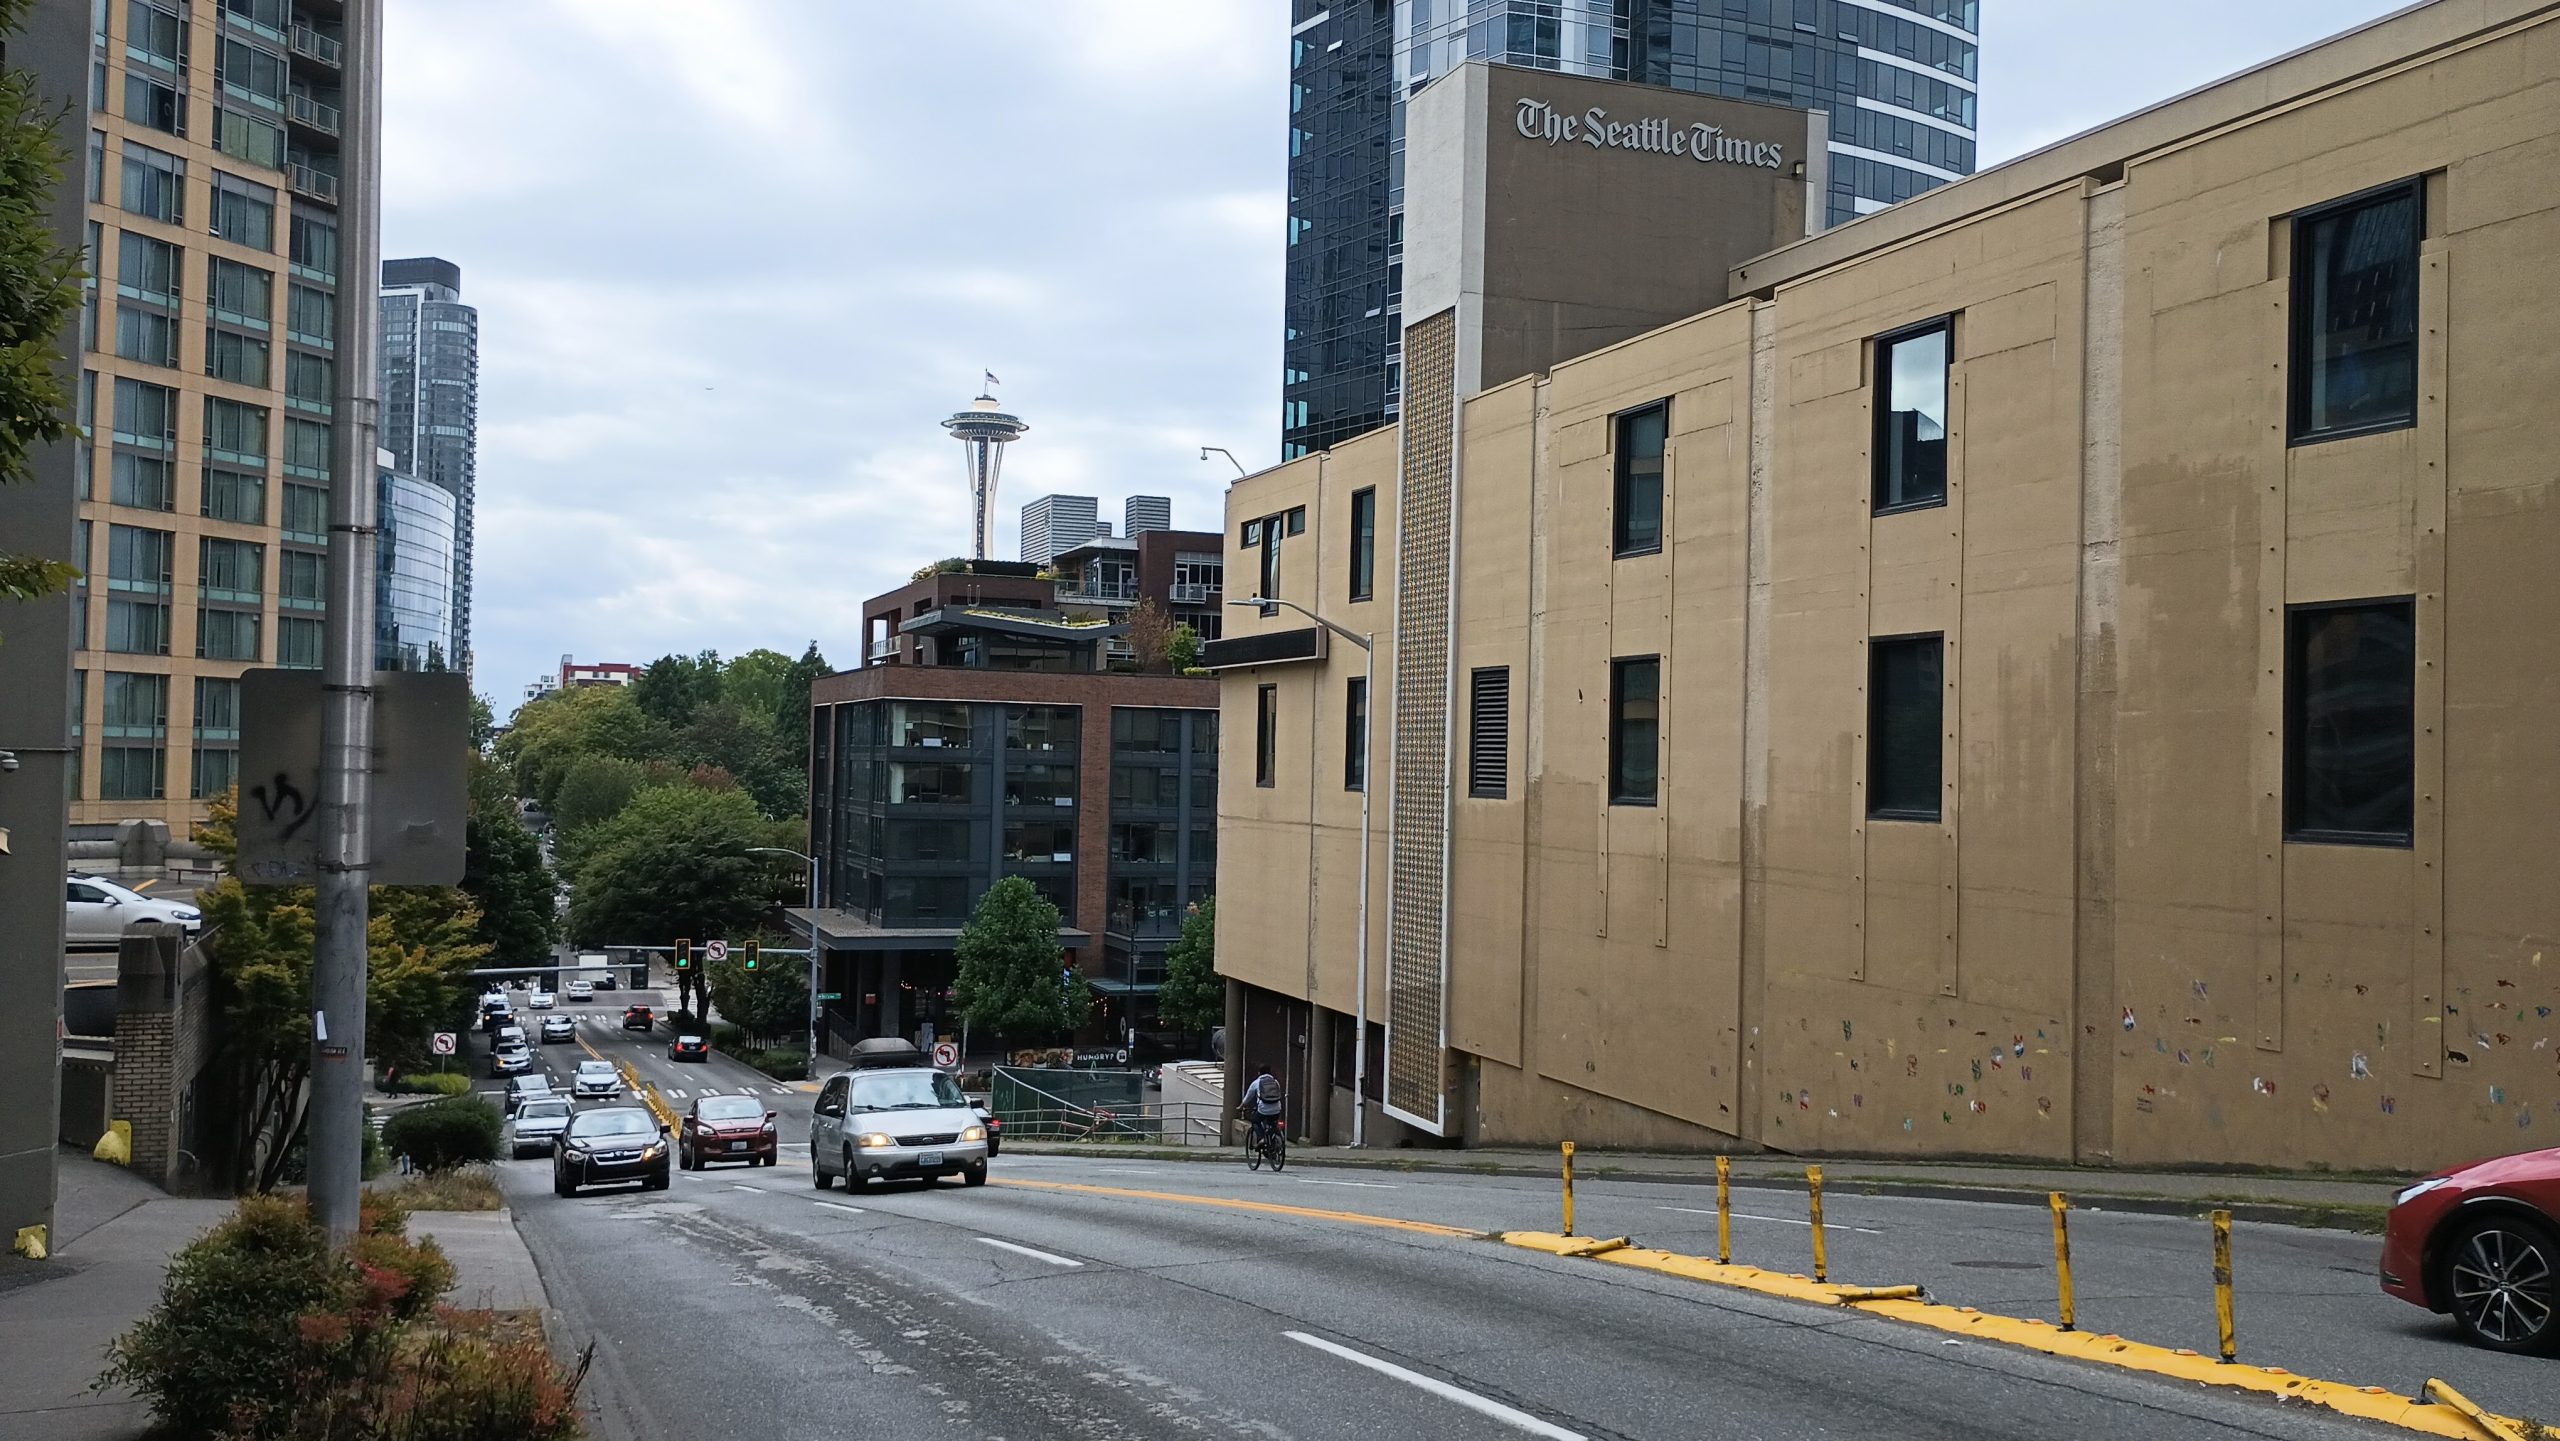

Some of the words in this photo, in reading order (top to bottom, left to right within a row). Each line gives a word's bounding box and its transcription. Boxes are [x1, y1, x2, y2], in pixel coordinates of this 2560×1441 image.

[1515, 97, 1578, 147] The
[1581, 106, 1687, 156] Seattle
[1690, 122, 1783, 169] Times
[1077, 1053, 1114, 1061] HUNGRY?
